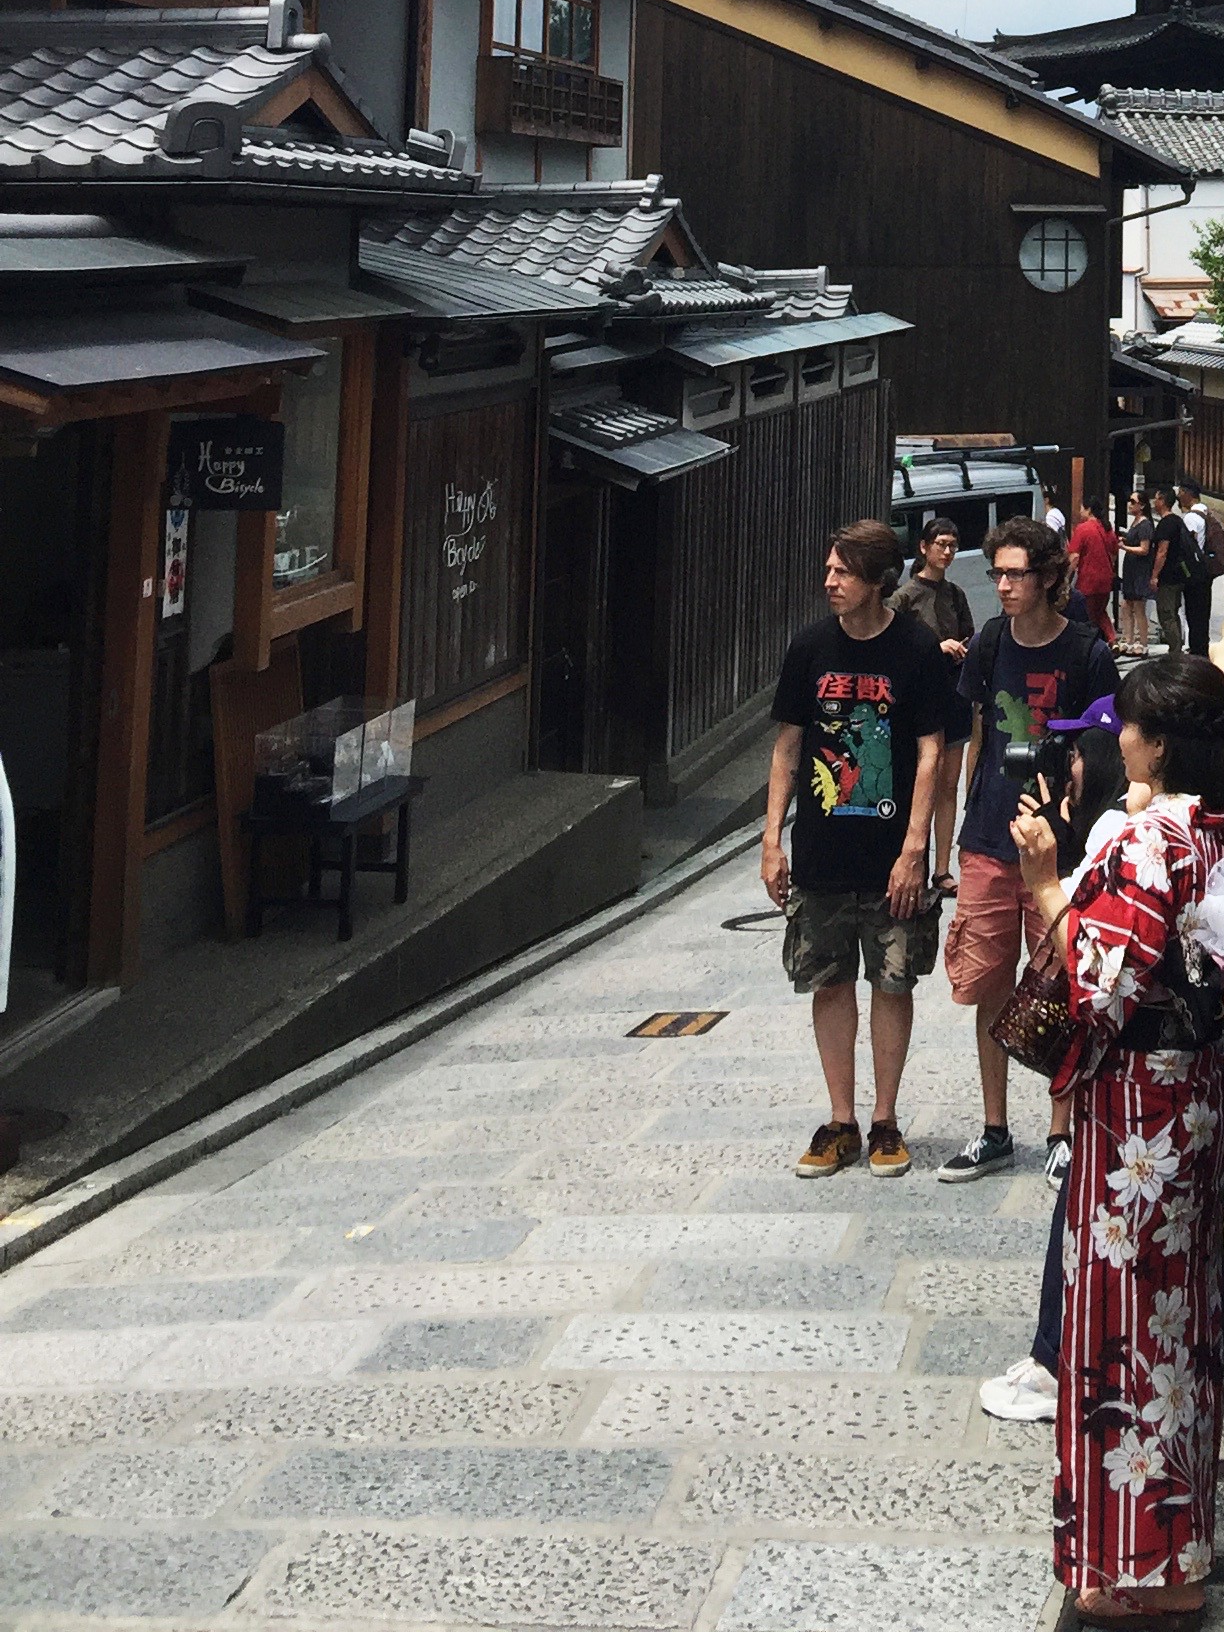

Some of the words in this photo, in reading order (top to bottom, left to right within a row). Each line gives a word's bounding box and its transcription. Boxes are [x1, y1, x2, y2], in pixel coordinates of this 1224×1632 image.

[198, 440, 246, 477] Happy
[444, 482, 477, 532] Happy
[816, 672, 896, 704] 怪獣
